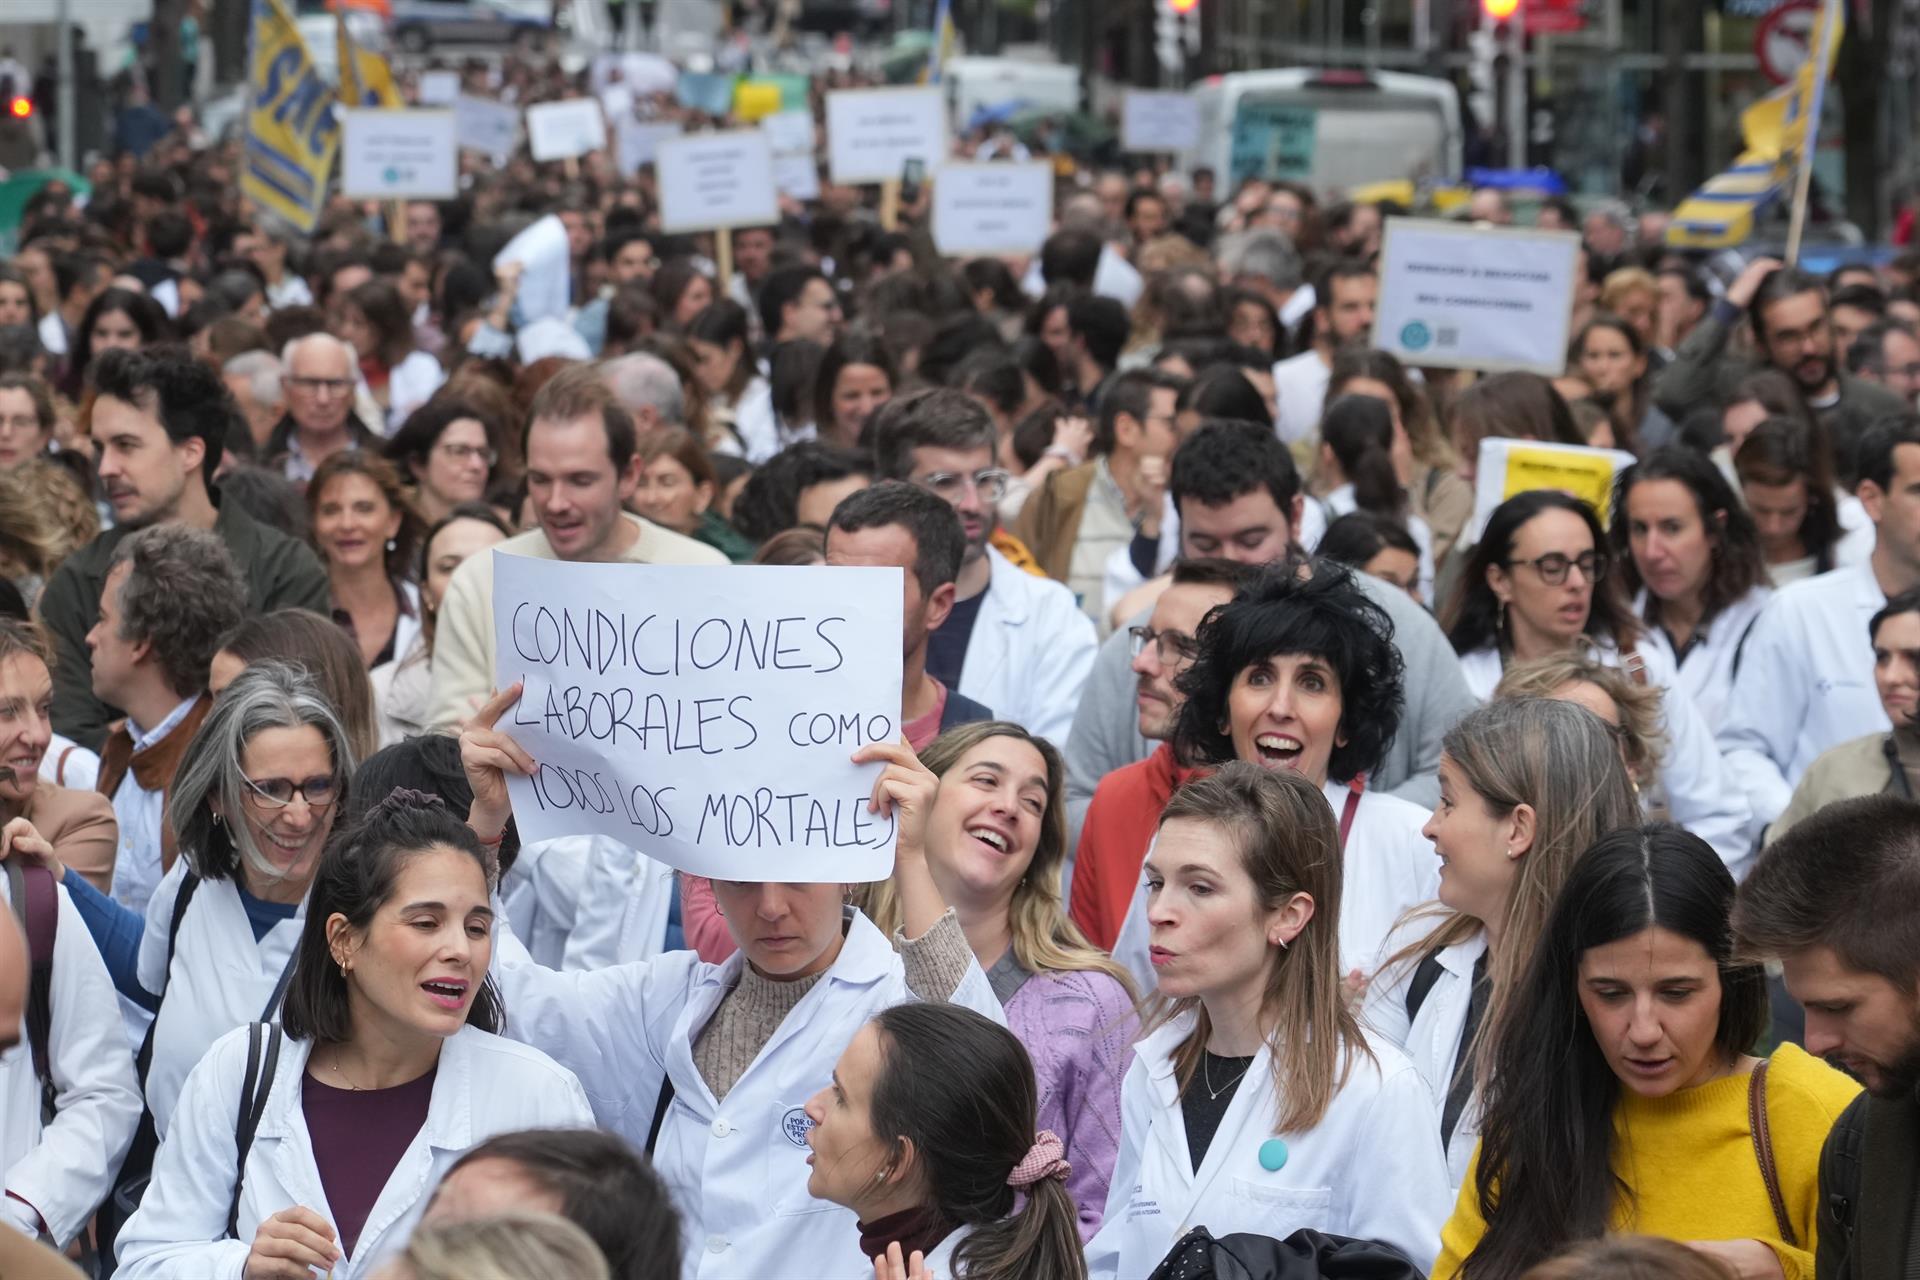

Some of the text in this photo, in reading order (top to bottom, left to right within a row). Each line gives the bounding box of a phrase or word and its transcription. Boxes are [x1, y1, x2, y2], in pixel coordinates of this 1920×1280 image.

[512, 602, 846, 676] CONDICIONES
[515, 674, 891, 755] LABORALES COMO
[614, 779, 677, 837] LOS
[790, 1117, 805, 1126] POR
